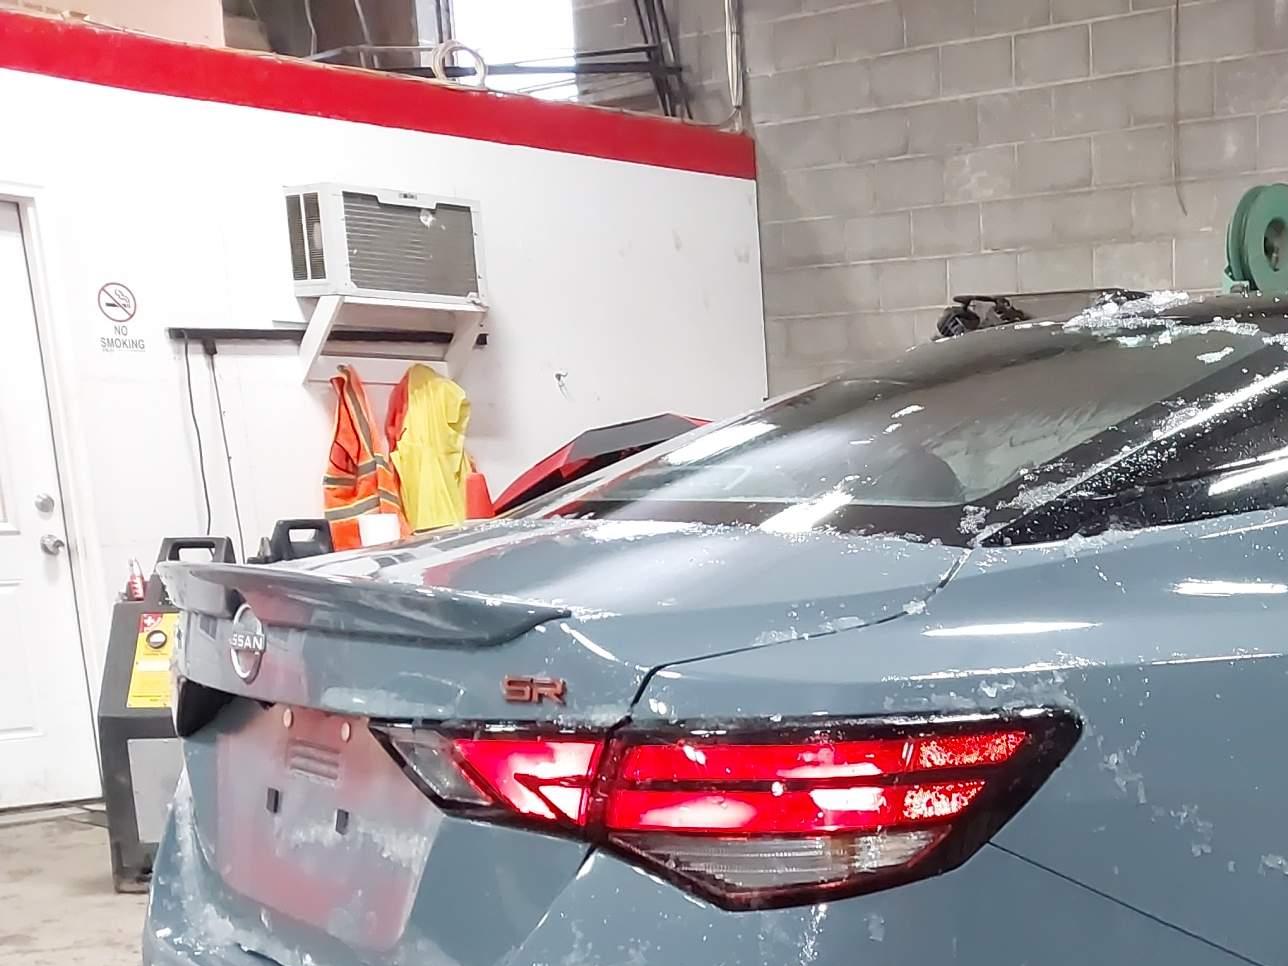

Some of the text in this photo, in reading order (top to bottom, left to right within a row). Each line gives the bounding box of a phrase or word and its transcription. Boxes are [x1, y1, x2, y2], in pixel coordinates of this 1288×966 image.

[113, 325, 128, 336] NO
[100, 337, 145, 349] SMOKING
[503, 677, 566, 705] SR
